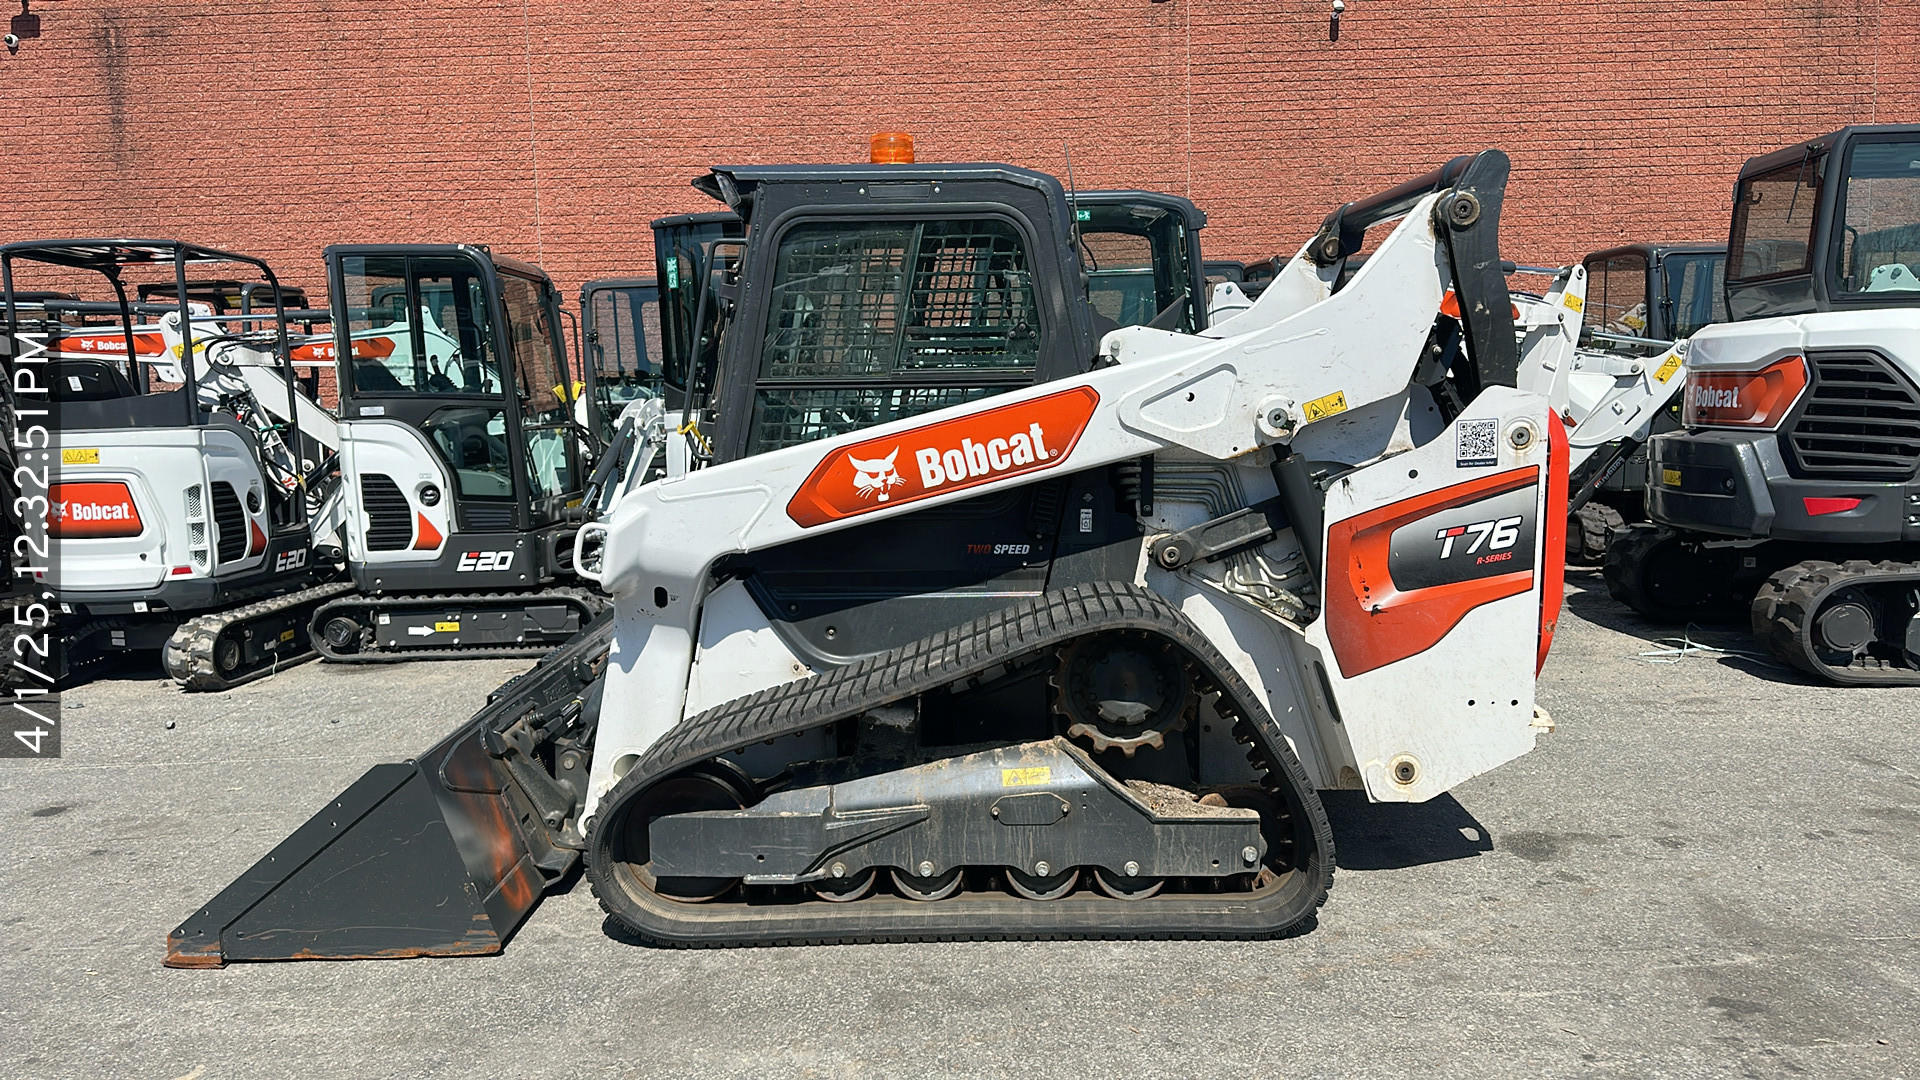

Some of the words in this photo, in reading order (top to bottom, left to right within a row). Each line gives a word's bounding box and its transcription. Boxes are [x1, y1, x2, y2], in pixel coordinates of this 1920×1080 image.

[97, 341, 128, 351] Bobca
[1695, 385, 1739, 408] Bobcat
[915, 422, 1050, 489] Bobcat
[71, 502, 130, 521] Bobcat
[1436, 515, 1523, 560] T76
[275, 548, 307, 573] E20
[967, 544, 992, 554] TWO
[993, 544, 1030, 555] SPEED
[1476, 551, 1513, 565] R-SERIES
[456, 550, 515, 572] E20
